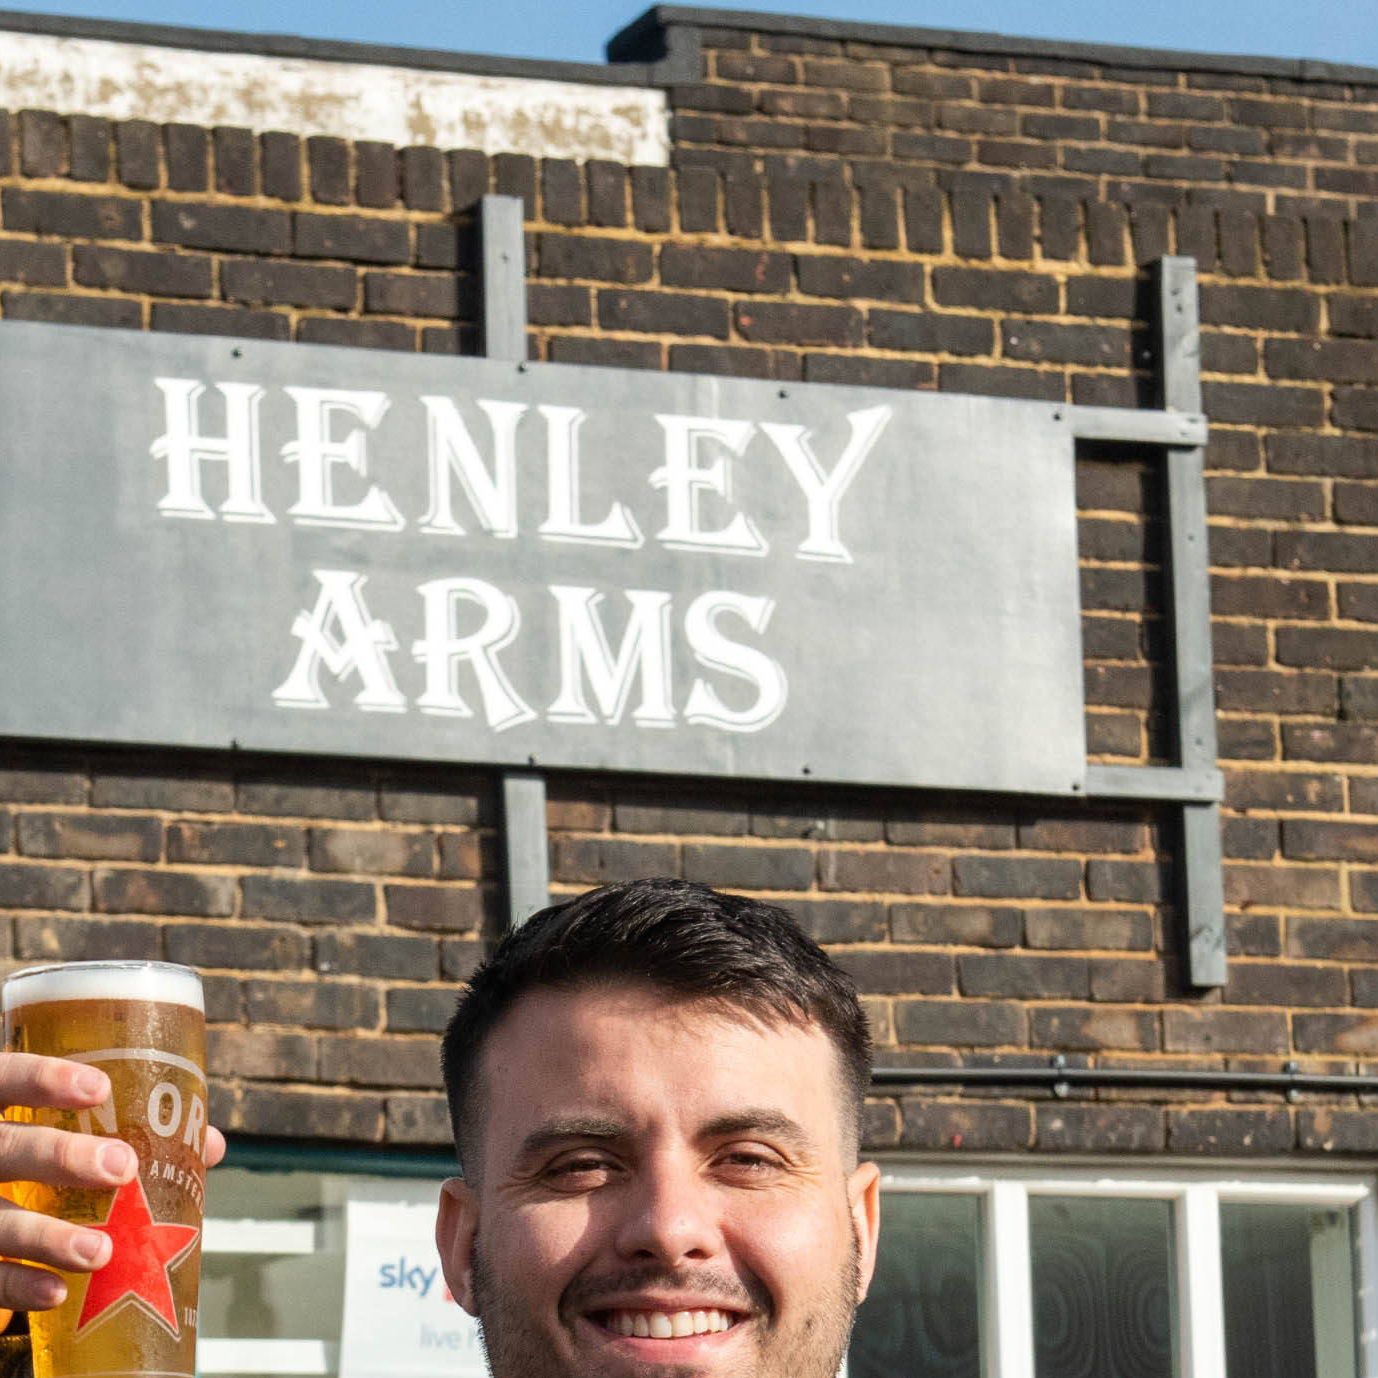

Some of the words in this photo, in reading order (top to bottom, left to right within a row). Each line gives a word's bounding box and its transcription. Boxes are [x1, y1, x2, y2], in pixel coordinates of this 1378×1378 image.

[150, 376, 893, 564] HENLEY
[272, 569, 790, 735] ARMS
[379, 1256, 438, 1299] sky
